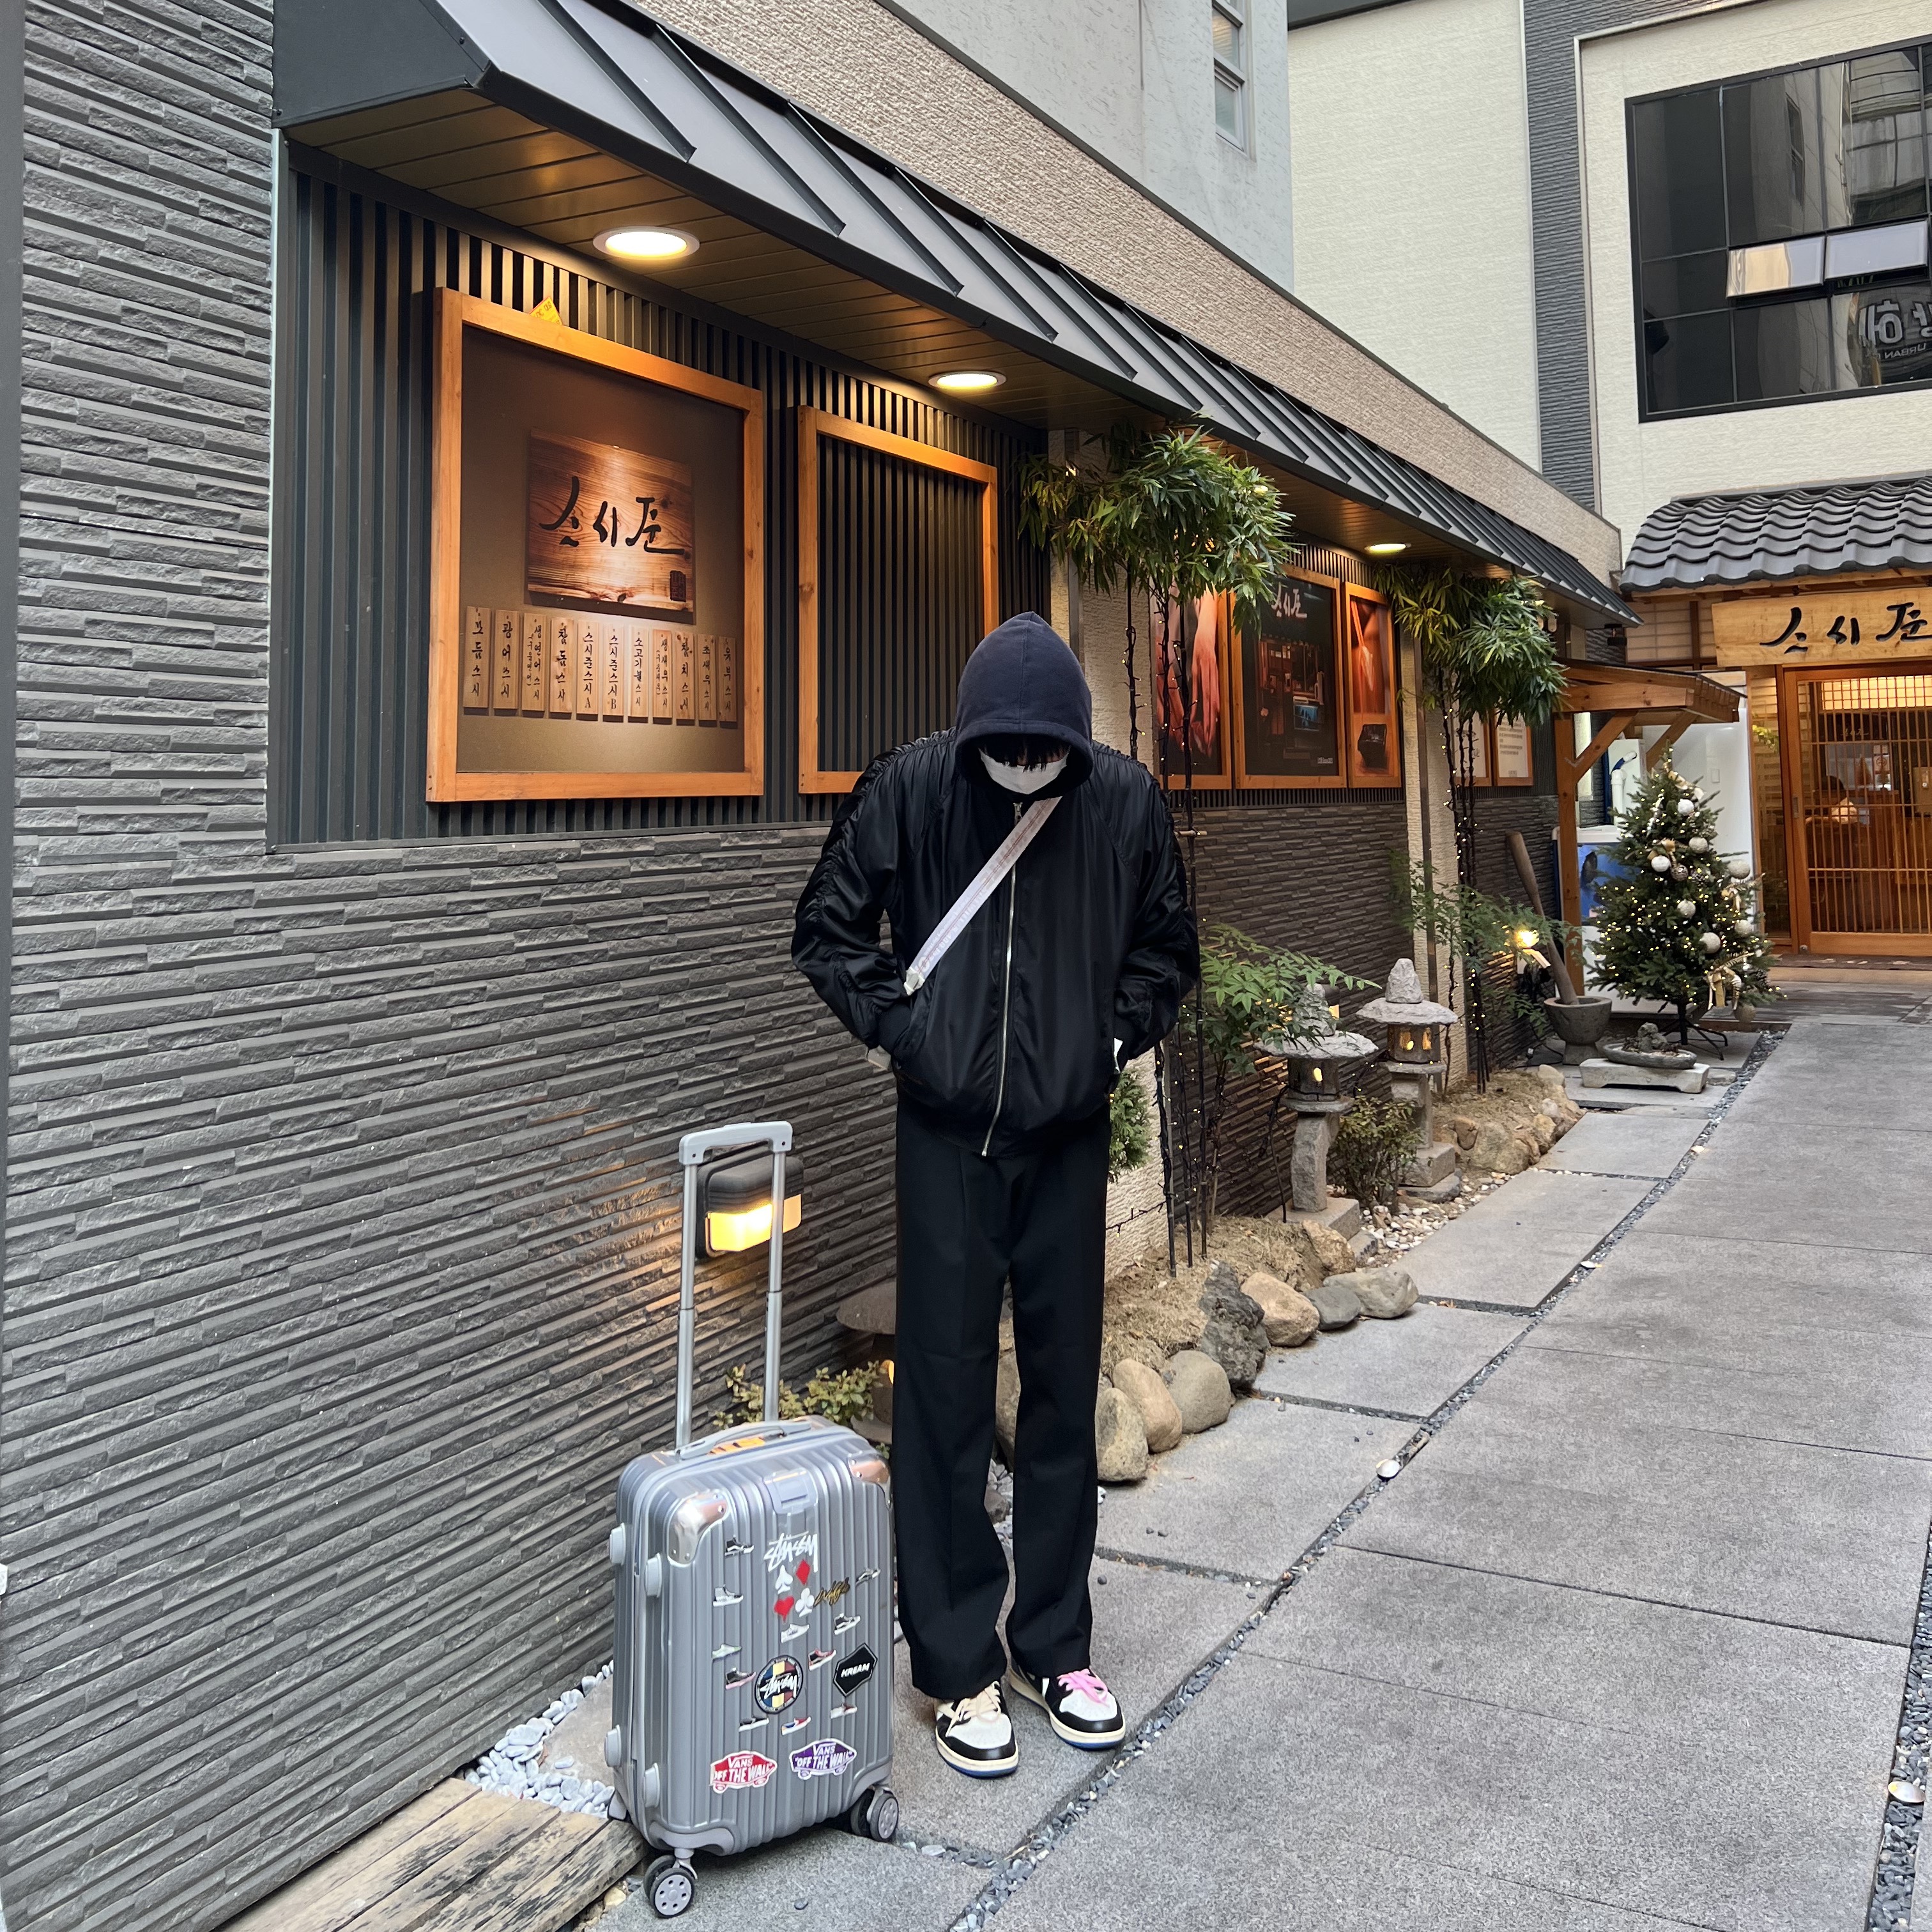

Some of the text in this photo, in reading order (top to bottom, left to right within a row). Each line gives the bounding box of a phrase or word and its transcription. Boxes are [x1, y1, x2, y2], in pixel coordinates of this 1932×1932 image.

[539, 476, 685, 554] 스시준
[471, 620, 484, 697] 모듬스시
[501, 621, 513, 698] 광어스시
[1759, 602, 1932, 654] 스시준
[557, 626, 568, 702] 참돔스시
[681, 637, 690, 710] 참치스시
[702, 645, 710, 711] 초새우스시
[723, 647, 732, 711] 유부스시
[841, 1662, 870, 1678] KREAM
[728, 1755, 753, 1769] VANS
[728, 1767, 748, 1782] THE
[812, 1755, 830, 1770] THE
[813, 1742, 836, 1756] VANS
